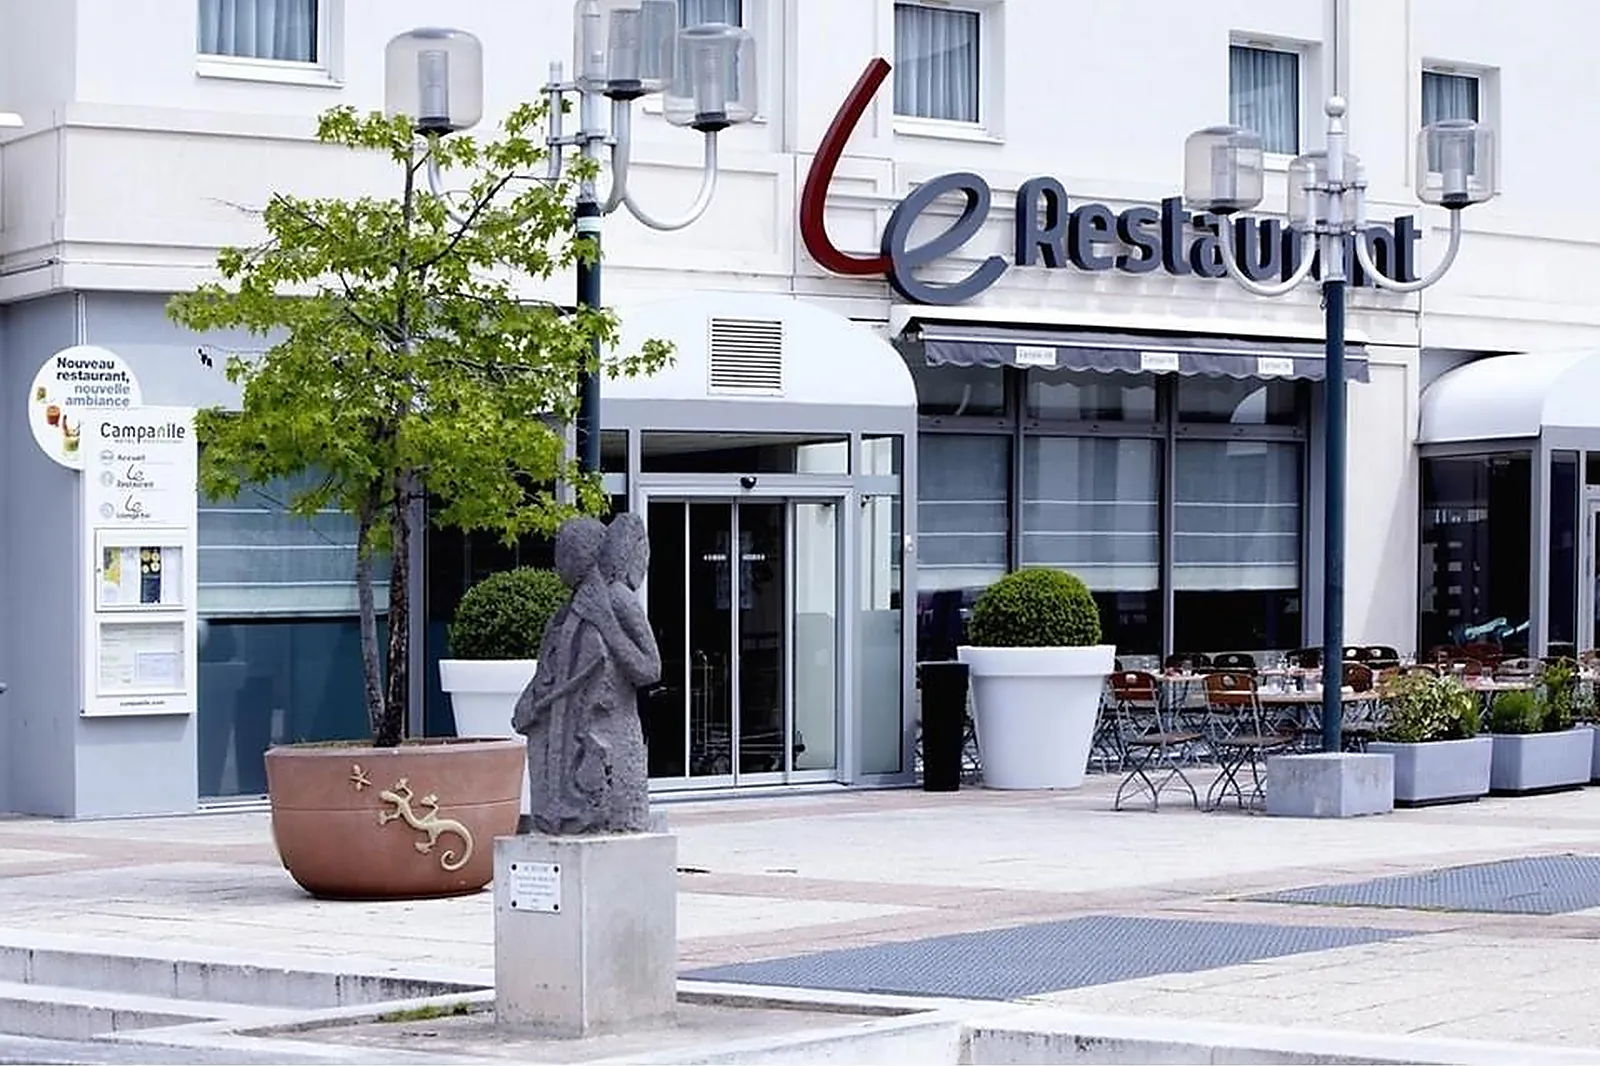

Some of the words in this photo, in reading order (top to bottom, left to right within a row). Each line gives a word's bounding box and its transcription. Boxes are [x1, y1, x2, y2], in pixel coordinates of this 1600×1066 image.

[800, 57, 1009, 305] Le
[56, 357, 115, 370] Nouveau
[56, 371, 131, 384] restaurant,
[74, 384, 131, 395] nouvelle
[65, 396, 131, 407] ambiance
[100, 422, 186, 444] Campanile
